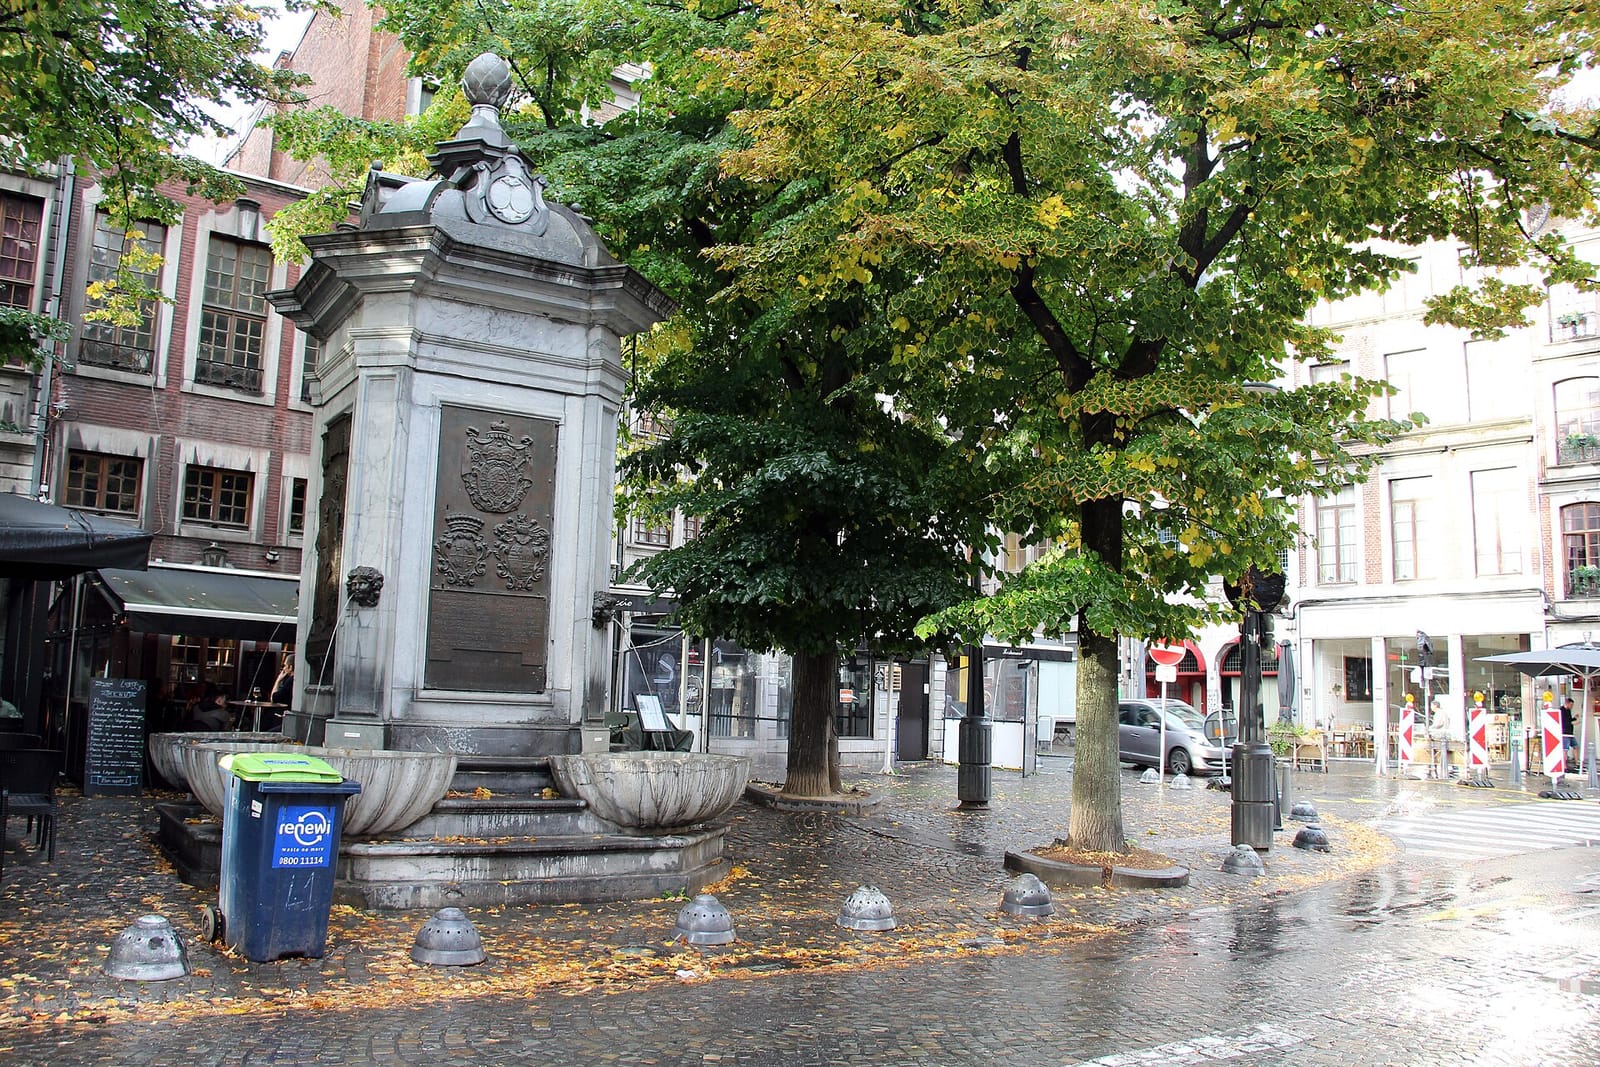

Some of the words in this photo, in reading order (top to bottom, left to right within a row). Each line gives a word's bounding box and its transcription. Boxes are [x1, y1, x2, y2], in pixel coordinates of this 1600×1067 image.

[279, 816, 331, 841] renewi
[279, 856, 299, 865] 0800
[300, 855, 323, 865] 11114
